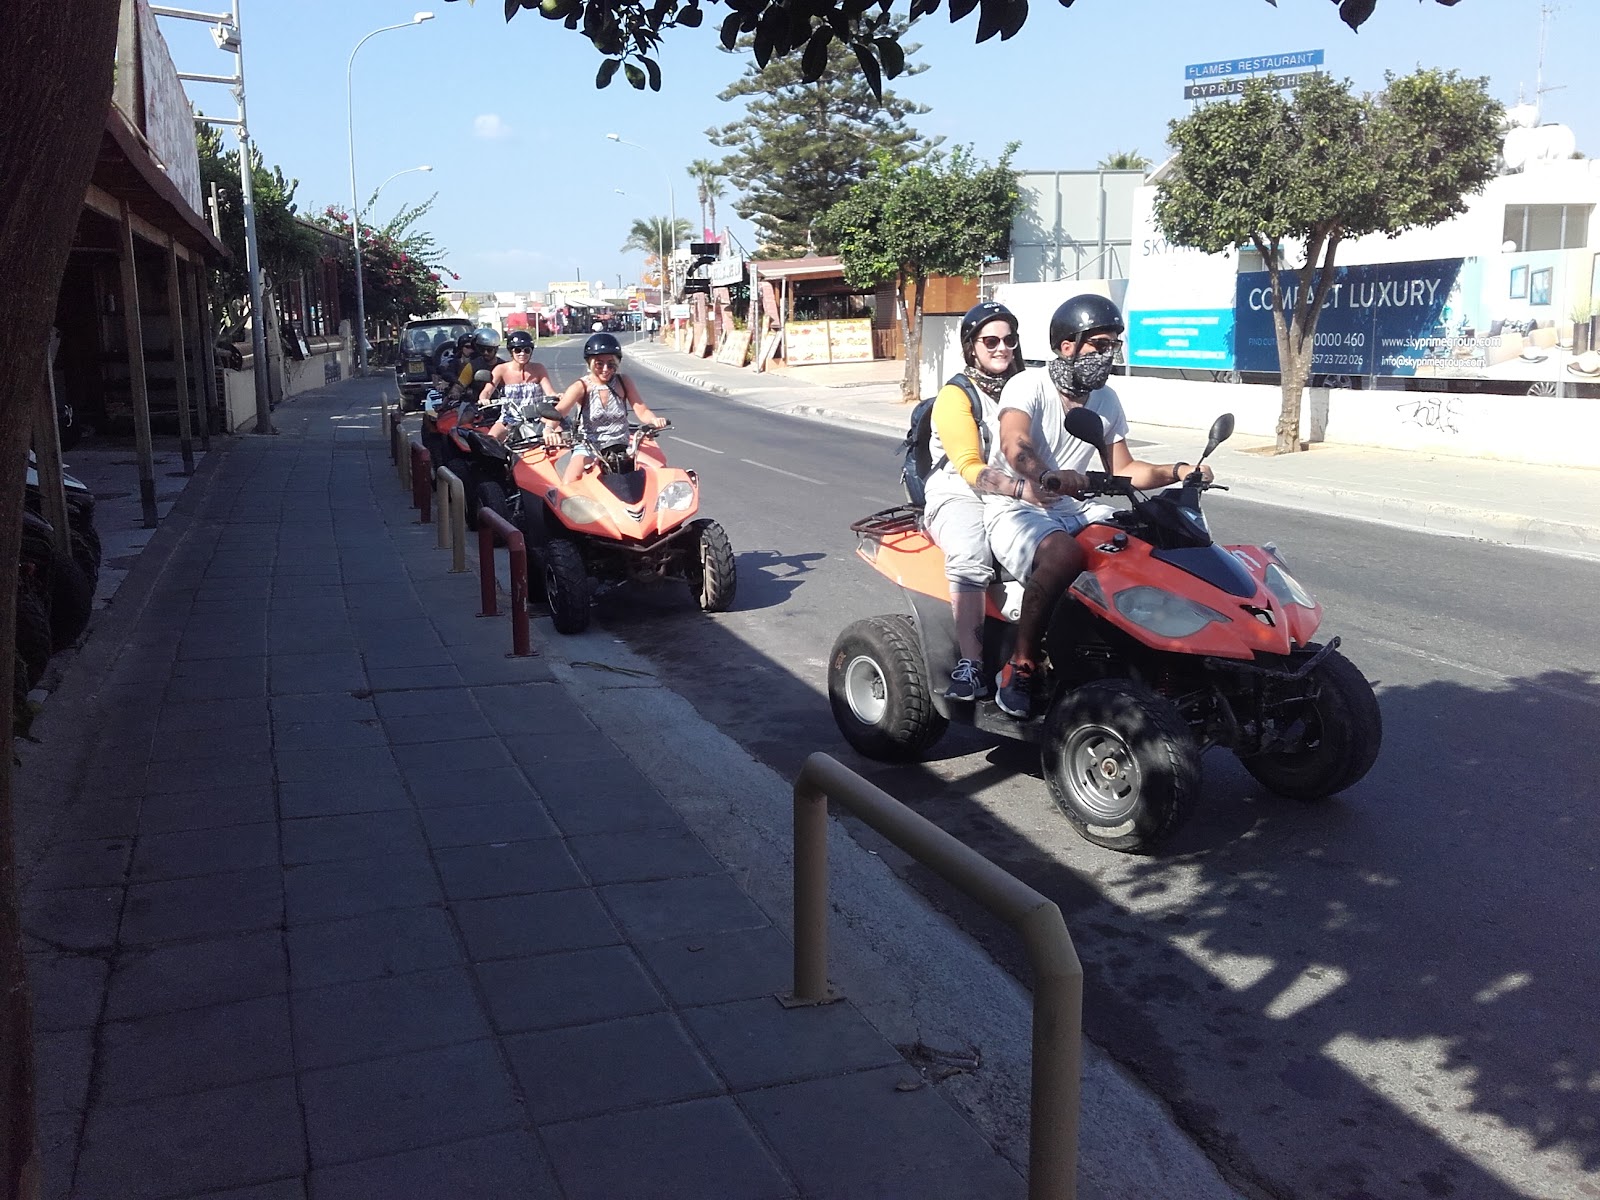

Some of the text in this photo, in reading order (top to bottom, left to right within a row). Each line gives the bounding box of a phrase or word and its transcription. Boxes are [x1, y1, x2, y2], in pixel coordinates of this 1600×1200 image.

[1189, 53, 1315, 77] FLAMES RESTAURANT
[1191, 81, 1244, 97] CYPRUS
[1349, 278, 1441, 308] LUXURY
[1343, 332, 1365, 347] 460
[1381, 335, 1502, 350] www.skyprimegroup.com
[1324, 354, 1334, 364] 23
[1334, 354, 1348, 365] 722
[1349, 355, 1364, 365] 026
[1381, 354, 1486, 369] info@skyprimegroup.com
